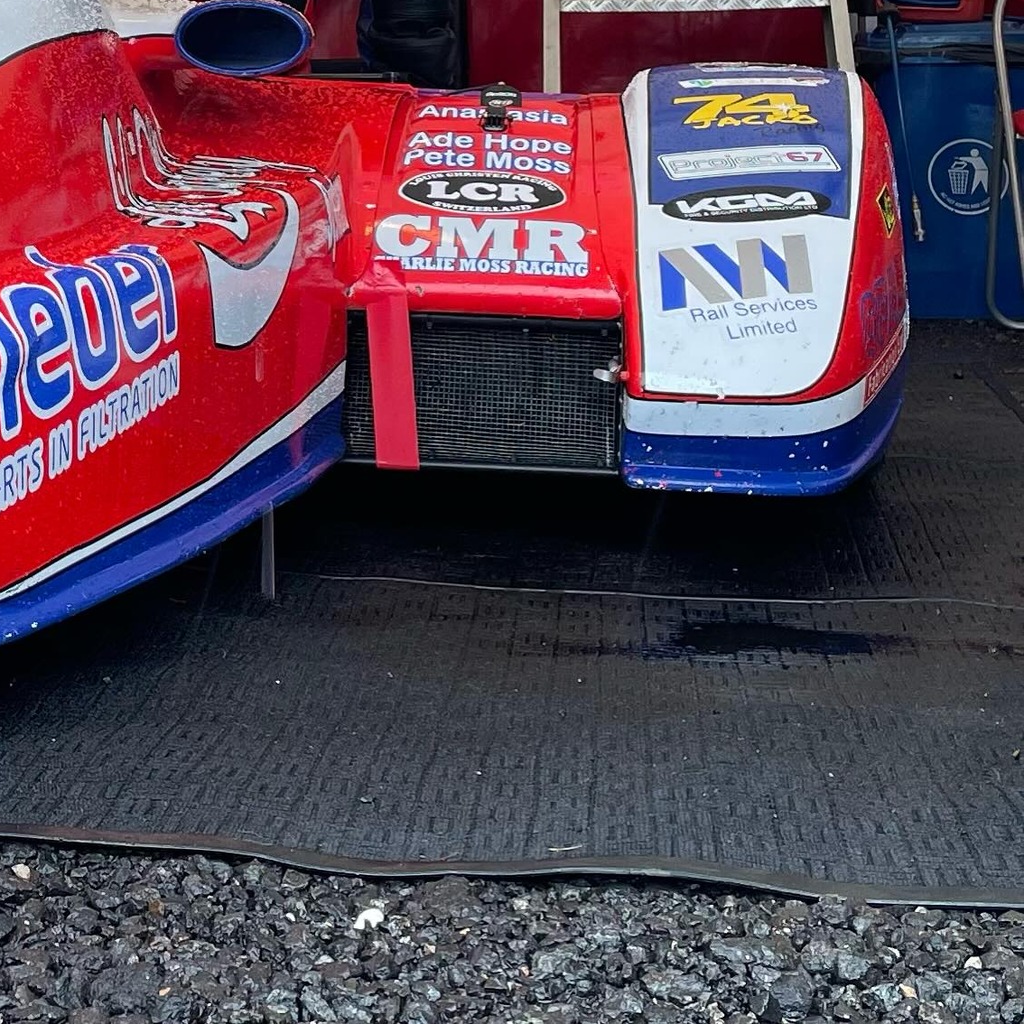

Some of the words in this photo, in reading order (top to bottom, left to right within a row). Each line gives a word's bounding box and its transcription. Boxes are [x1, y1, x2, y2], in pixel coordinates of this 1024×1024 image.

[418, 105, 568, 126] Anaasia
[672, 91, 811, 125] 74
[408, 131, 474, 148] Ade
[484, 133, 572, 155] Hope
[403, 148, 475, 167] Pete
[486, 151, 571, 174] Moss
[408, 172, 443, 187] LOUIS
[445, 170, 510, 179] CHRISTEN
[512, 174, 558, 193] RACING
[426, 180, 540, 203] LCR
[431, 201, 532, 213] SWITZERLAND
[676, 191, 818, 214] KGM
[374, 214, 589, 264] CMR
[374, 255, 456, 272] ARLIE
[458, 258, 512, 274] MOSS
[514, 260, 589, 277] RACING
[689, 304, 729, 324] Rail
[733, 298, 818, 317] Services
[726, 317, 798, 342] Limited
[50, 422, 72, 478] IN
[78, 353, 179, 459] FILTRATION
